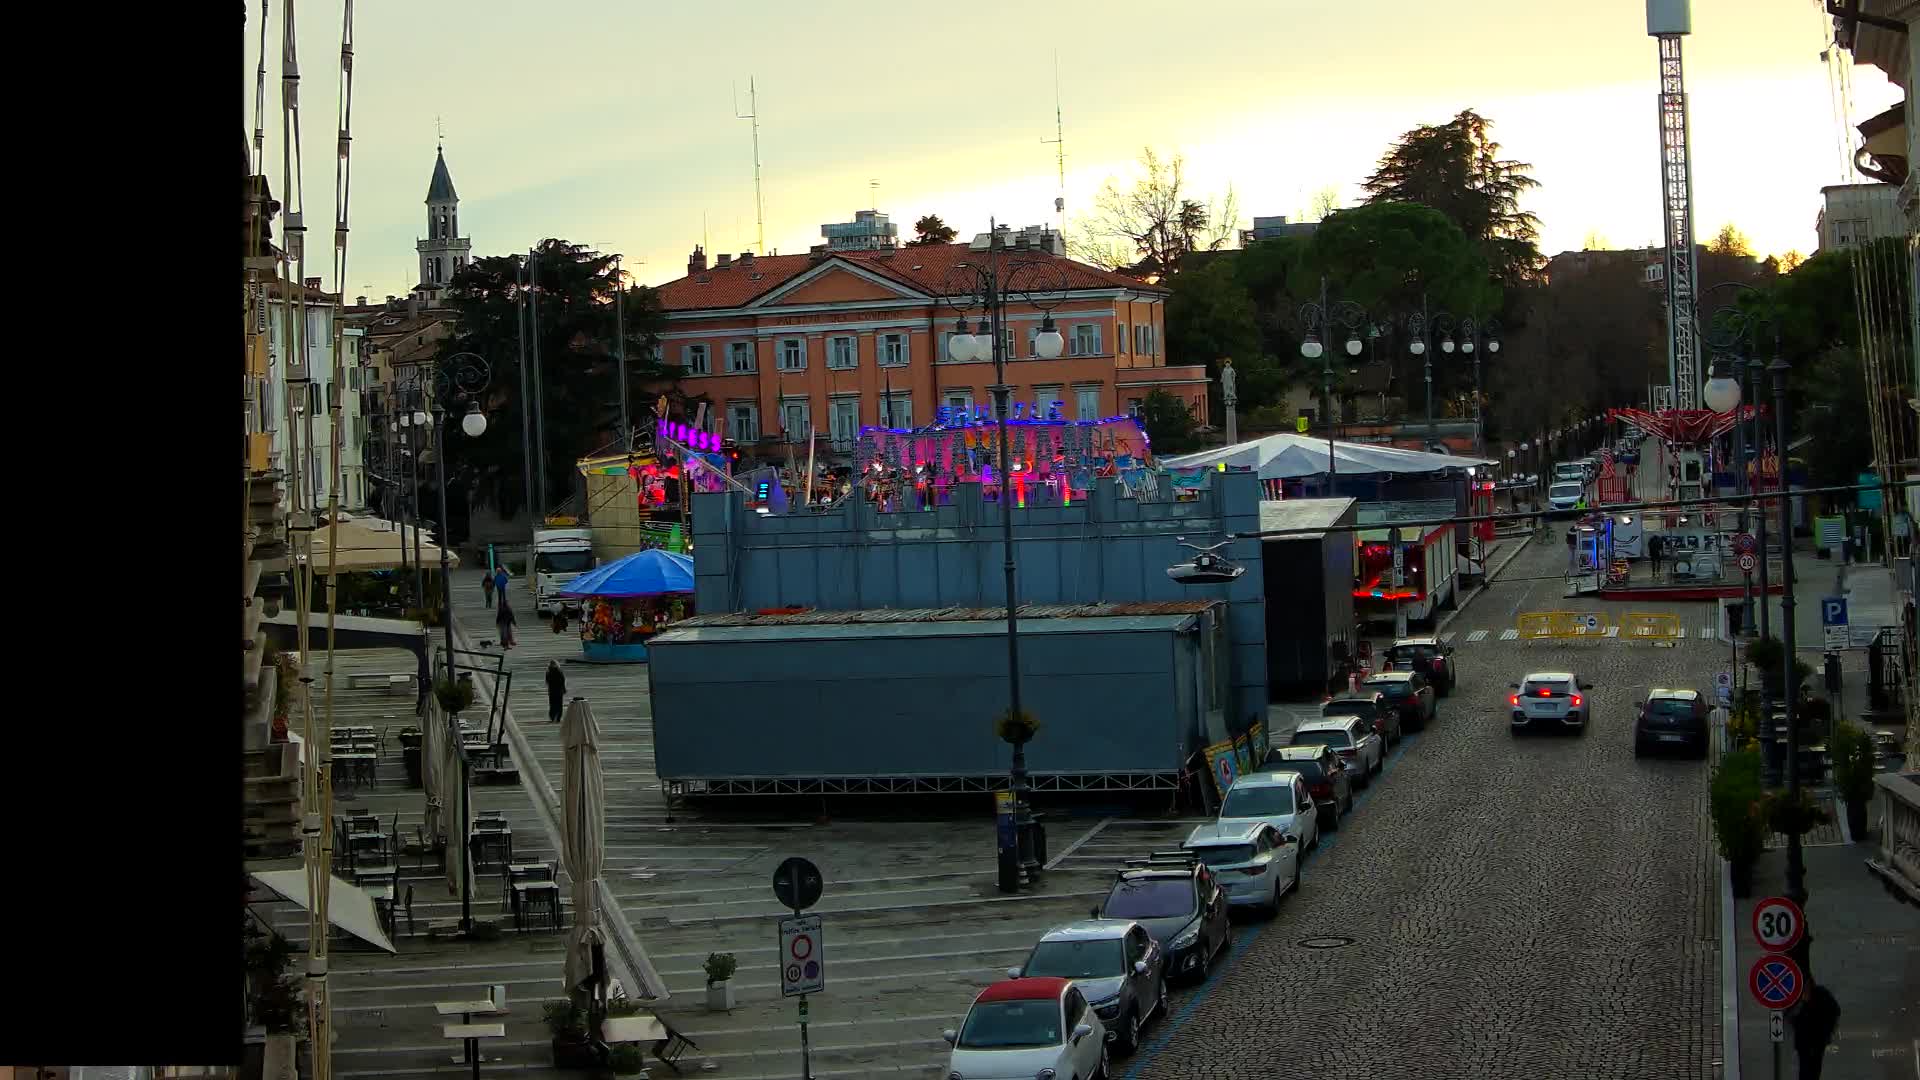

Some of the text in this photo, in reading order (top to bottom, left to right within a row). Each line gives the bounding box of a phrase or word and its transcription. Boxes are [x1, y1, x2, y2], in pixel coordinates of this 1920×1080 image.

[1742, 557, 1752, 567] 20
[1826, 602, 1841, 622] P
[1762, 912, 1791, 938] 30
